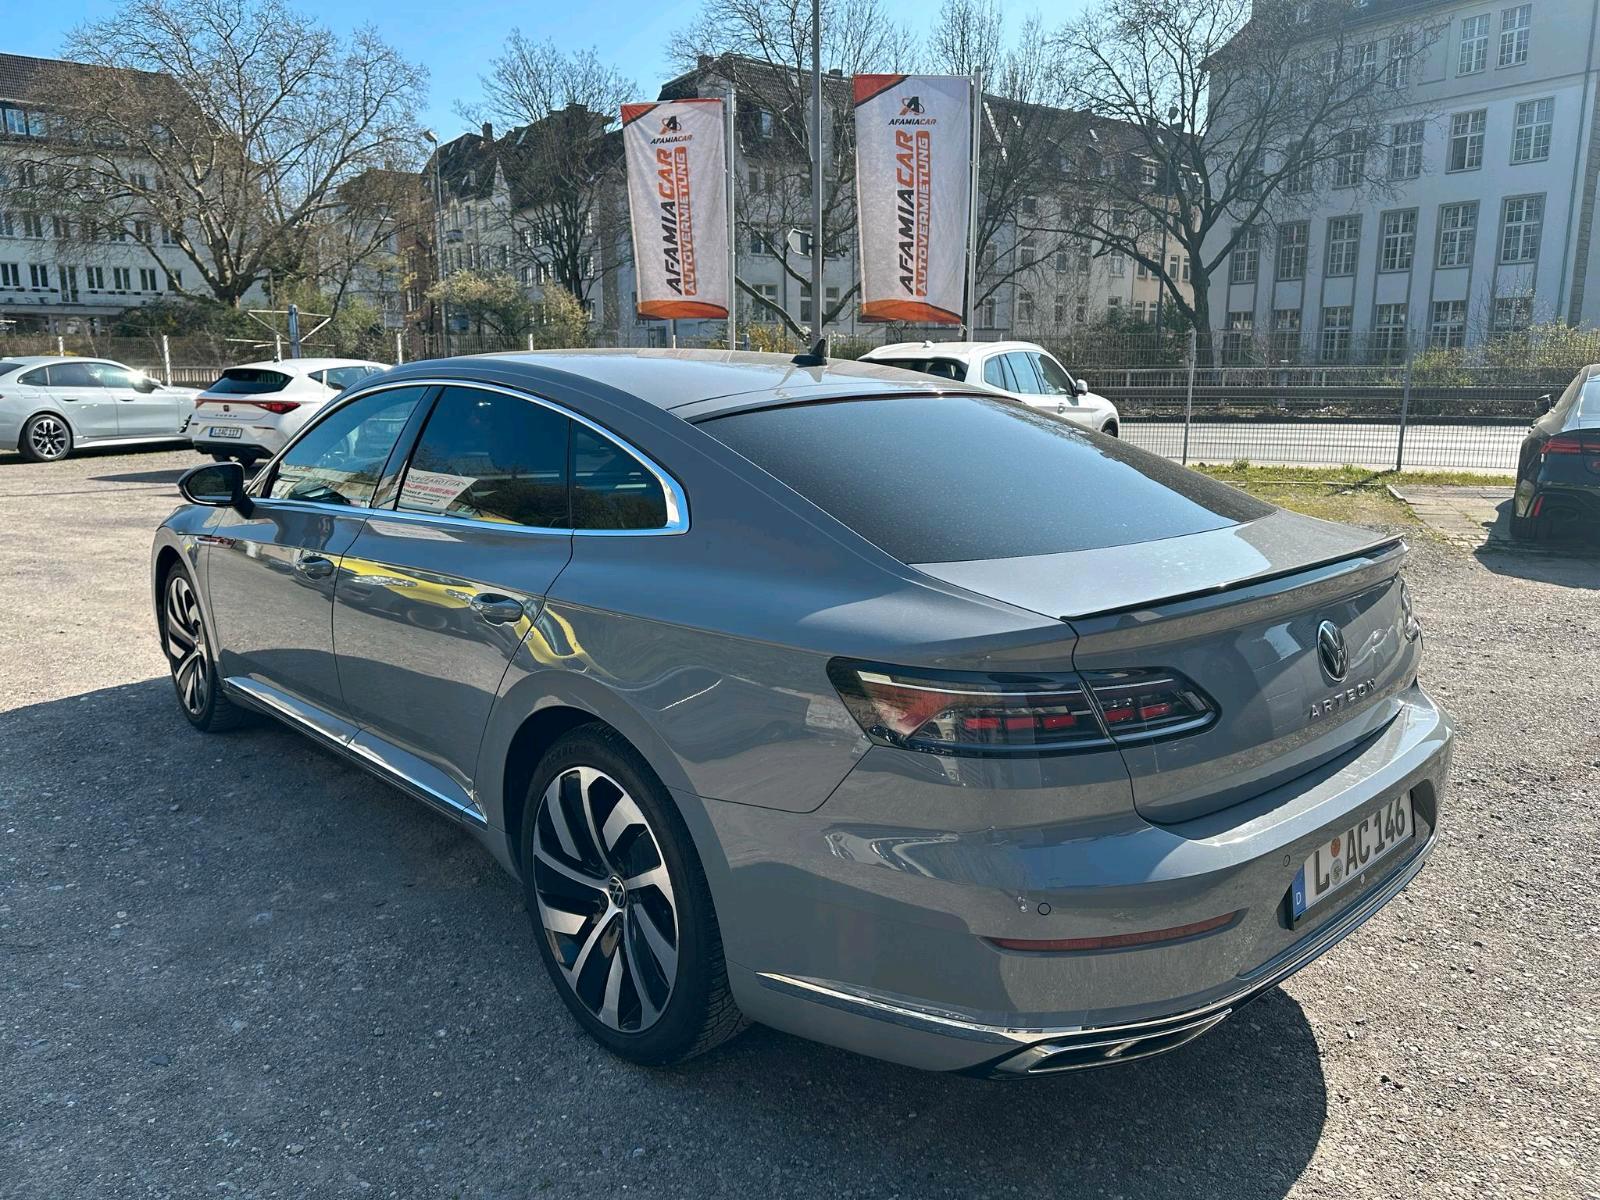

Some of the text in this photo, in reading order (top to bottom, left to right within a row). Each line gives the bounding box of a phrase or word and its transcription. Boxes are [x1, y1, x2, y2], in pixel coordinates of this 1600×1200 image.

[650, 134, 694, 145] AFAMIACAR
[888, 118, 937, 126] AFAMIACAR
[656, 147, 683, 296] AFAMIACAR
[675, 151, 696, 294] AUTOVERMIETUNG
[896, 129, 915, 296] AFAMIACAR
[917, 136, 930, 294] AUTOVERMIETUNG
[1310, 677, 1376, 719] ARTEON
[1373, 796, 1406, 856] 146
[1296, 891, 1302, 906] D
